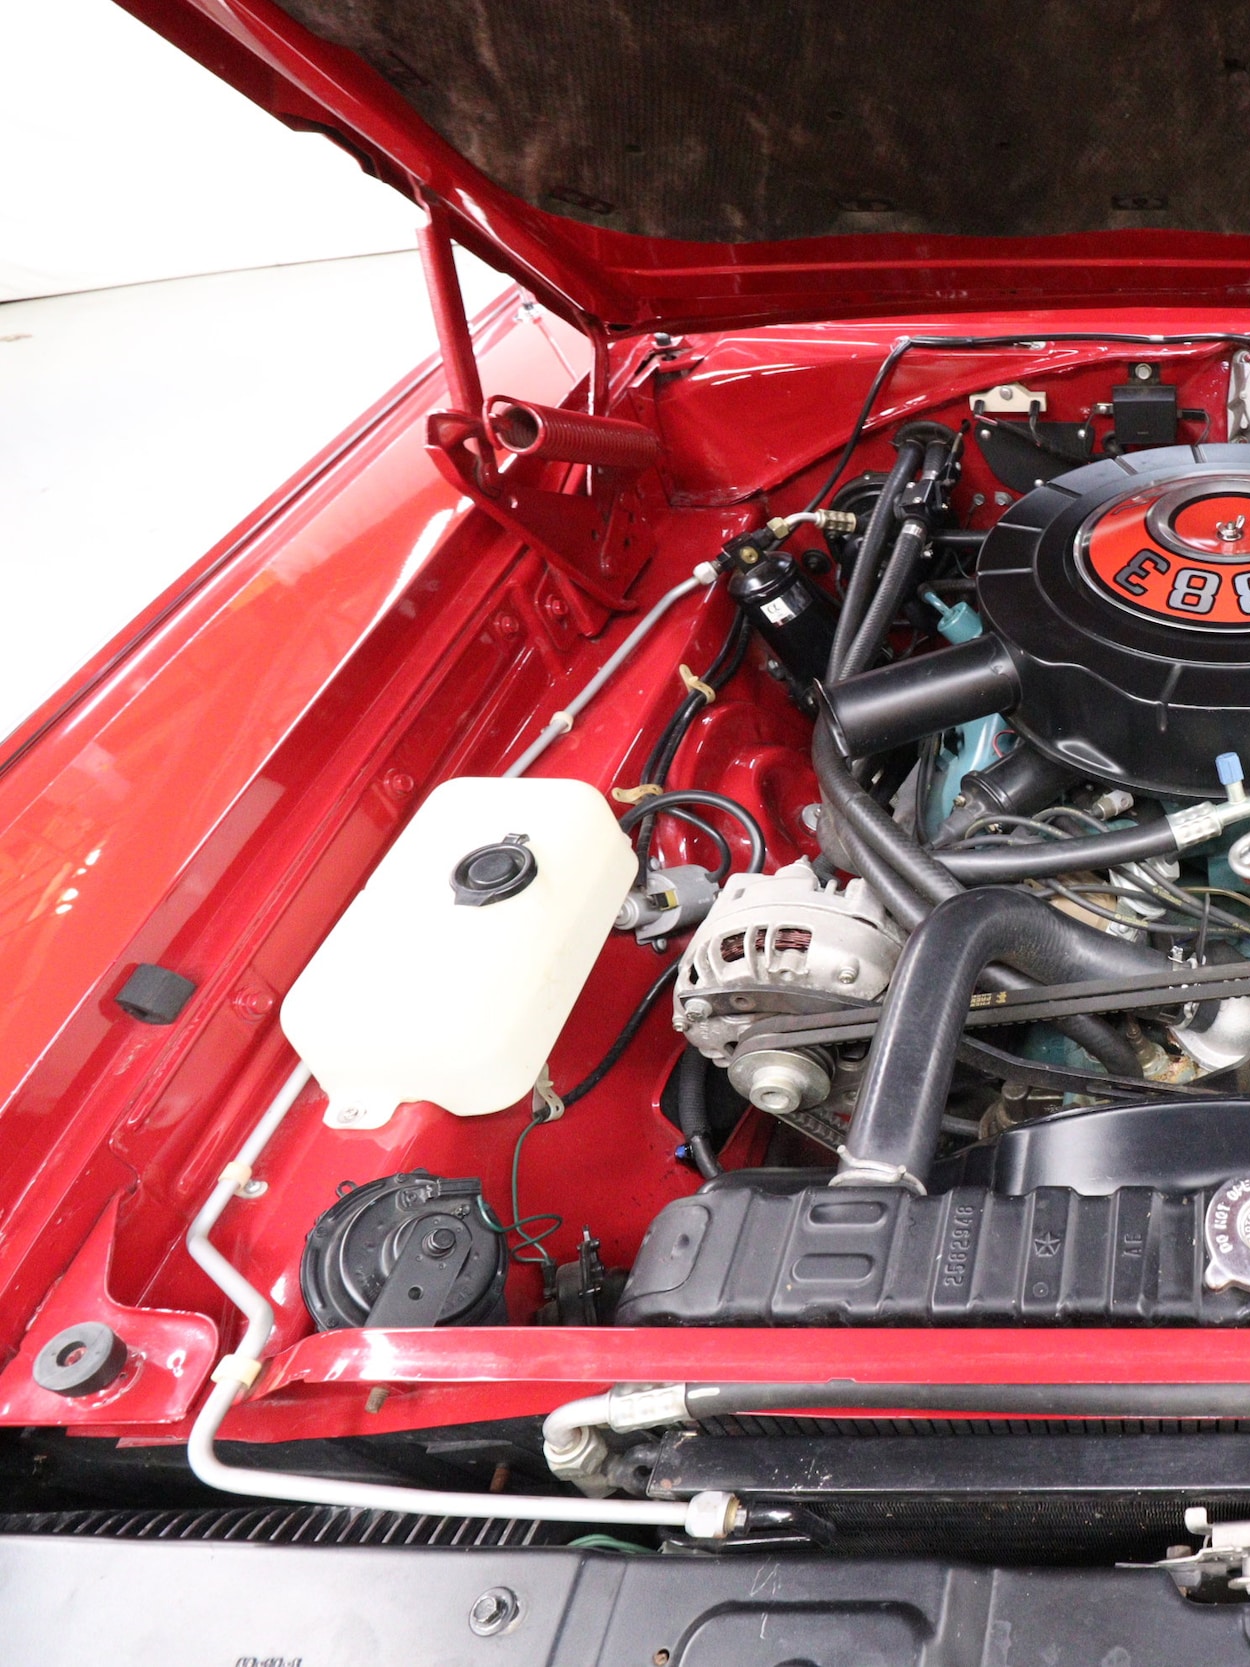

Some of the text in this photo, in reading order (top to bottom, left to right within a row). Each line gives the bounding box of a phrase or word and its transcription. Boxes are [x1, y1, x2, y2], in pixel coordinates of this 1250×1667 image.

[1214, 1203, 1231, 1229] NOT
[942, 1205, 974, 1287] 2582948
[1214, 1235, 1234, 1254] DO
